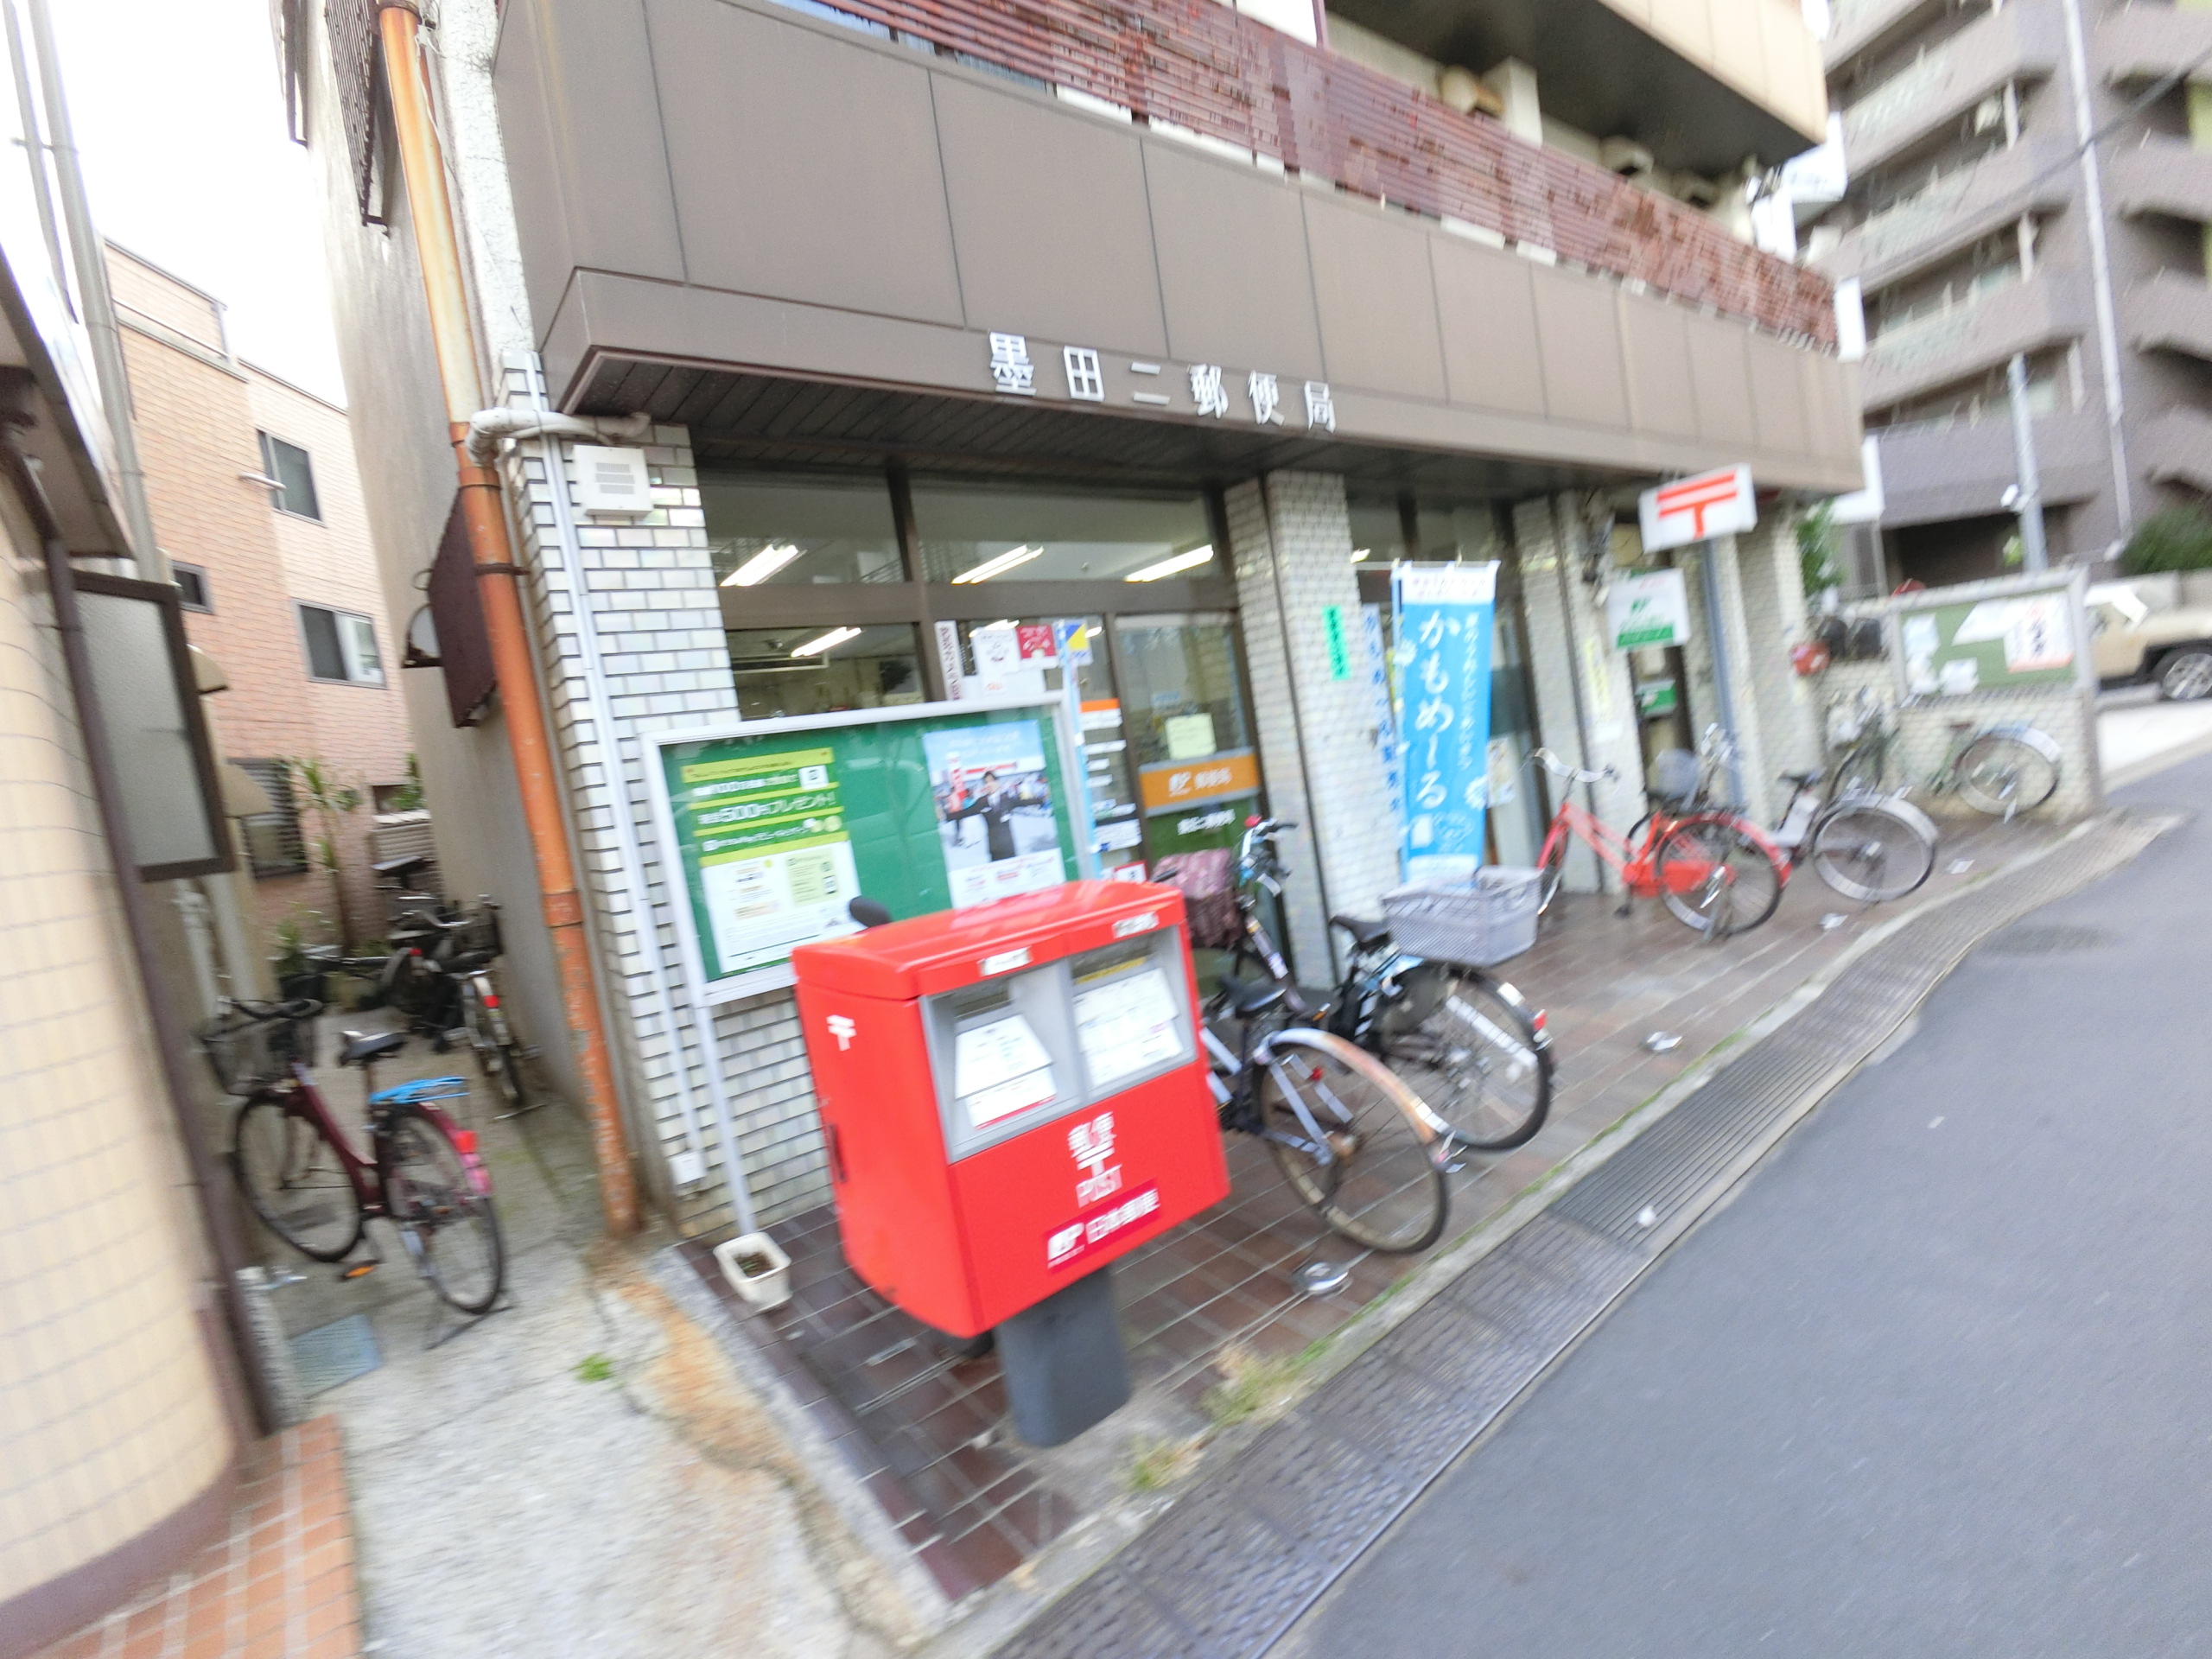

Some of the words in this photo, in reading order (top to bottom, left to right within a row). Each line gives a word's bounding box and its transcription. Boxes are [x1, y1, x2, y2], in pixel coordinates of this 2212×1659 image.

[988, 331, 1336, 433] 墨田二郵便局
